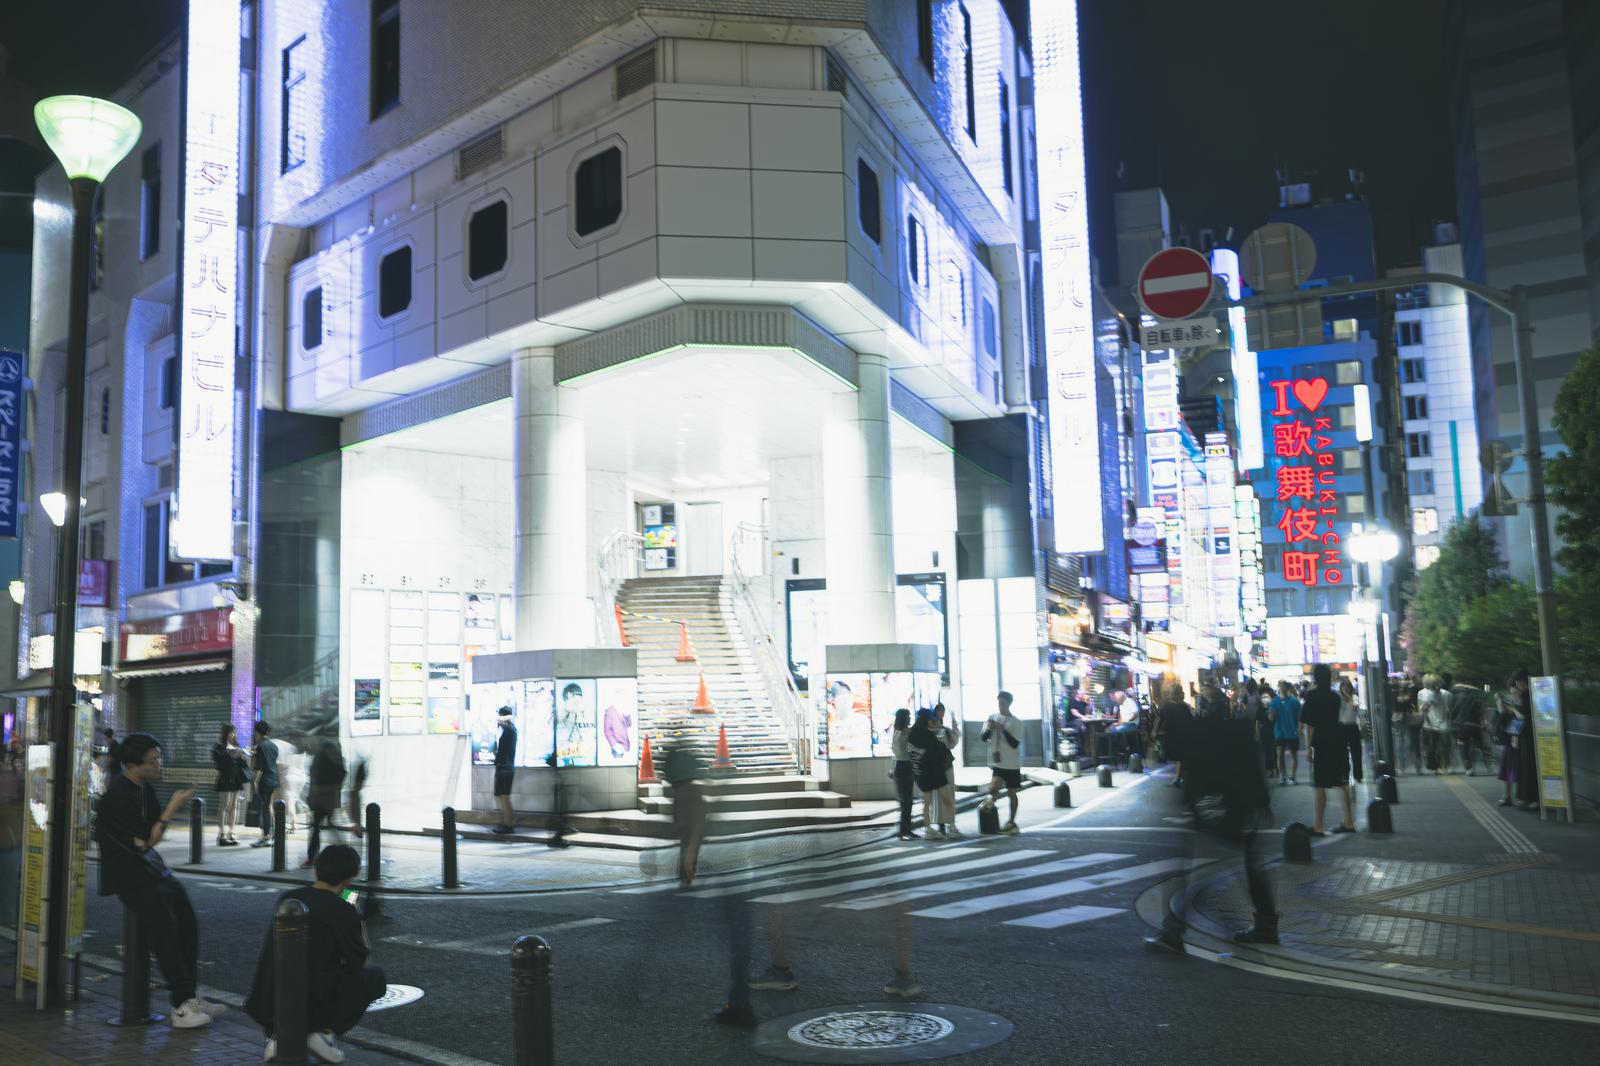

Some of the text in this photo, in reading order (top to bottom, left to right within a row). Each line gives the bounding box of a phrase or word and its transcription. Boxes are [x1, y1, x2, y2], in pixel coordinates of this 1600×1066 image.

[1147, 324, 1213, 346] 自転車を除く
[1270, 380, 1293, 417] I
[1273, 420, 1321, 587] 歌舞伎町
[1314, 417, 1343, 585] KABUKI-CHO
